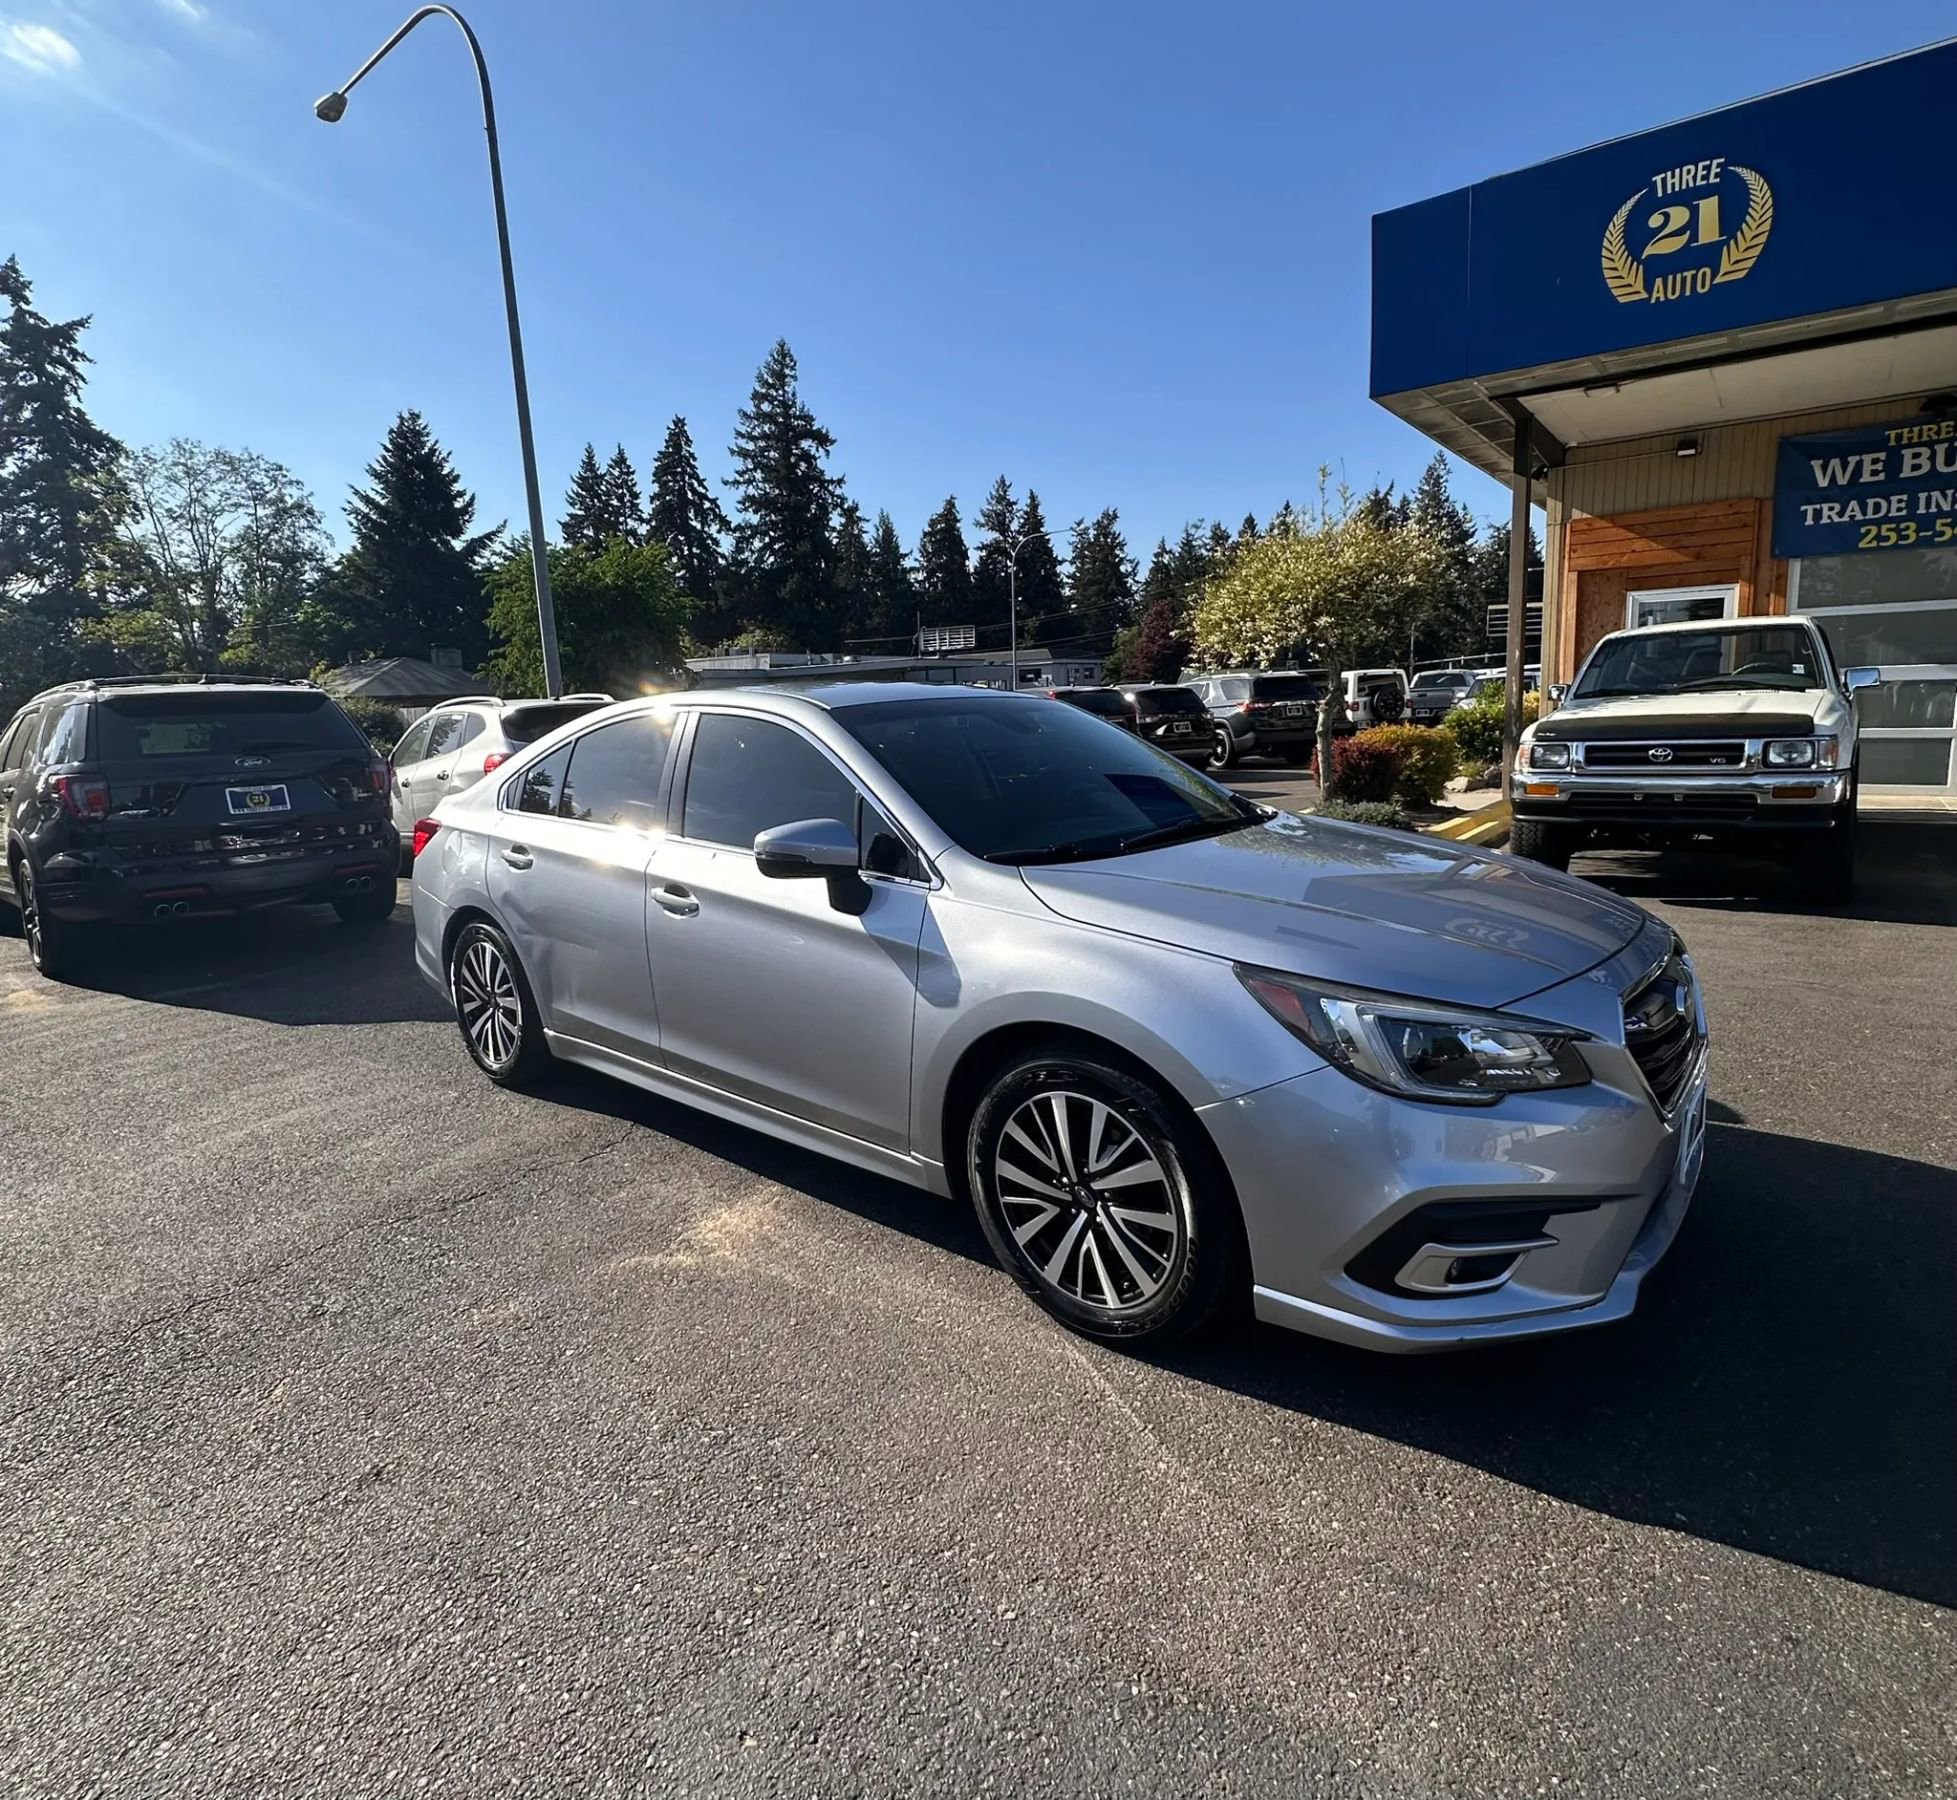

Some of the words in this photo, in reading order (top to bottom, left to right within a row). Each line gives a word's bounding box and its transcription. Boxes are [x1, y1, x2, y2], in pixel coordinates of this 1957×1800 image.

[1652, 157, 1725, 198] THREE
[1641, 195, 1727, 259] 21
[1650, 267, 1712, 304] AUTO
[1885, 421, 1957, 446] THRE
[1810, 451, 1887, 488] WE
[1800, 494, 1908, 526] TRADE
[1916, 489, 1957, 515] IN
[1858, 518, 1957, 549] 253-5
